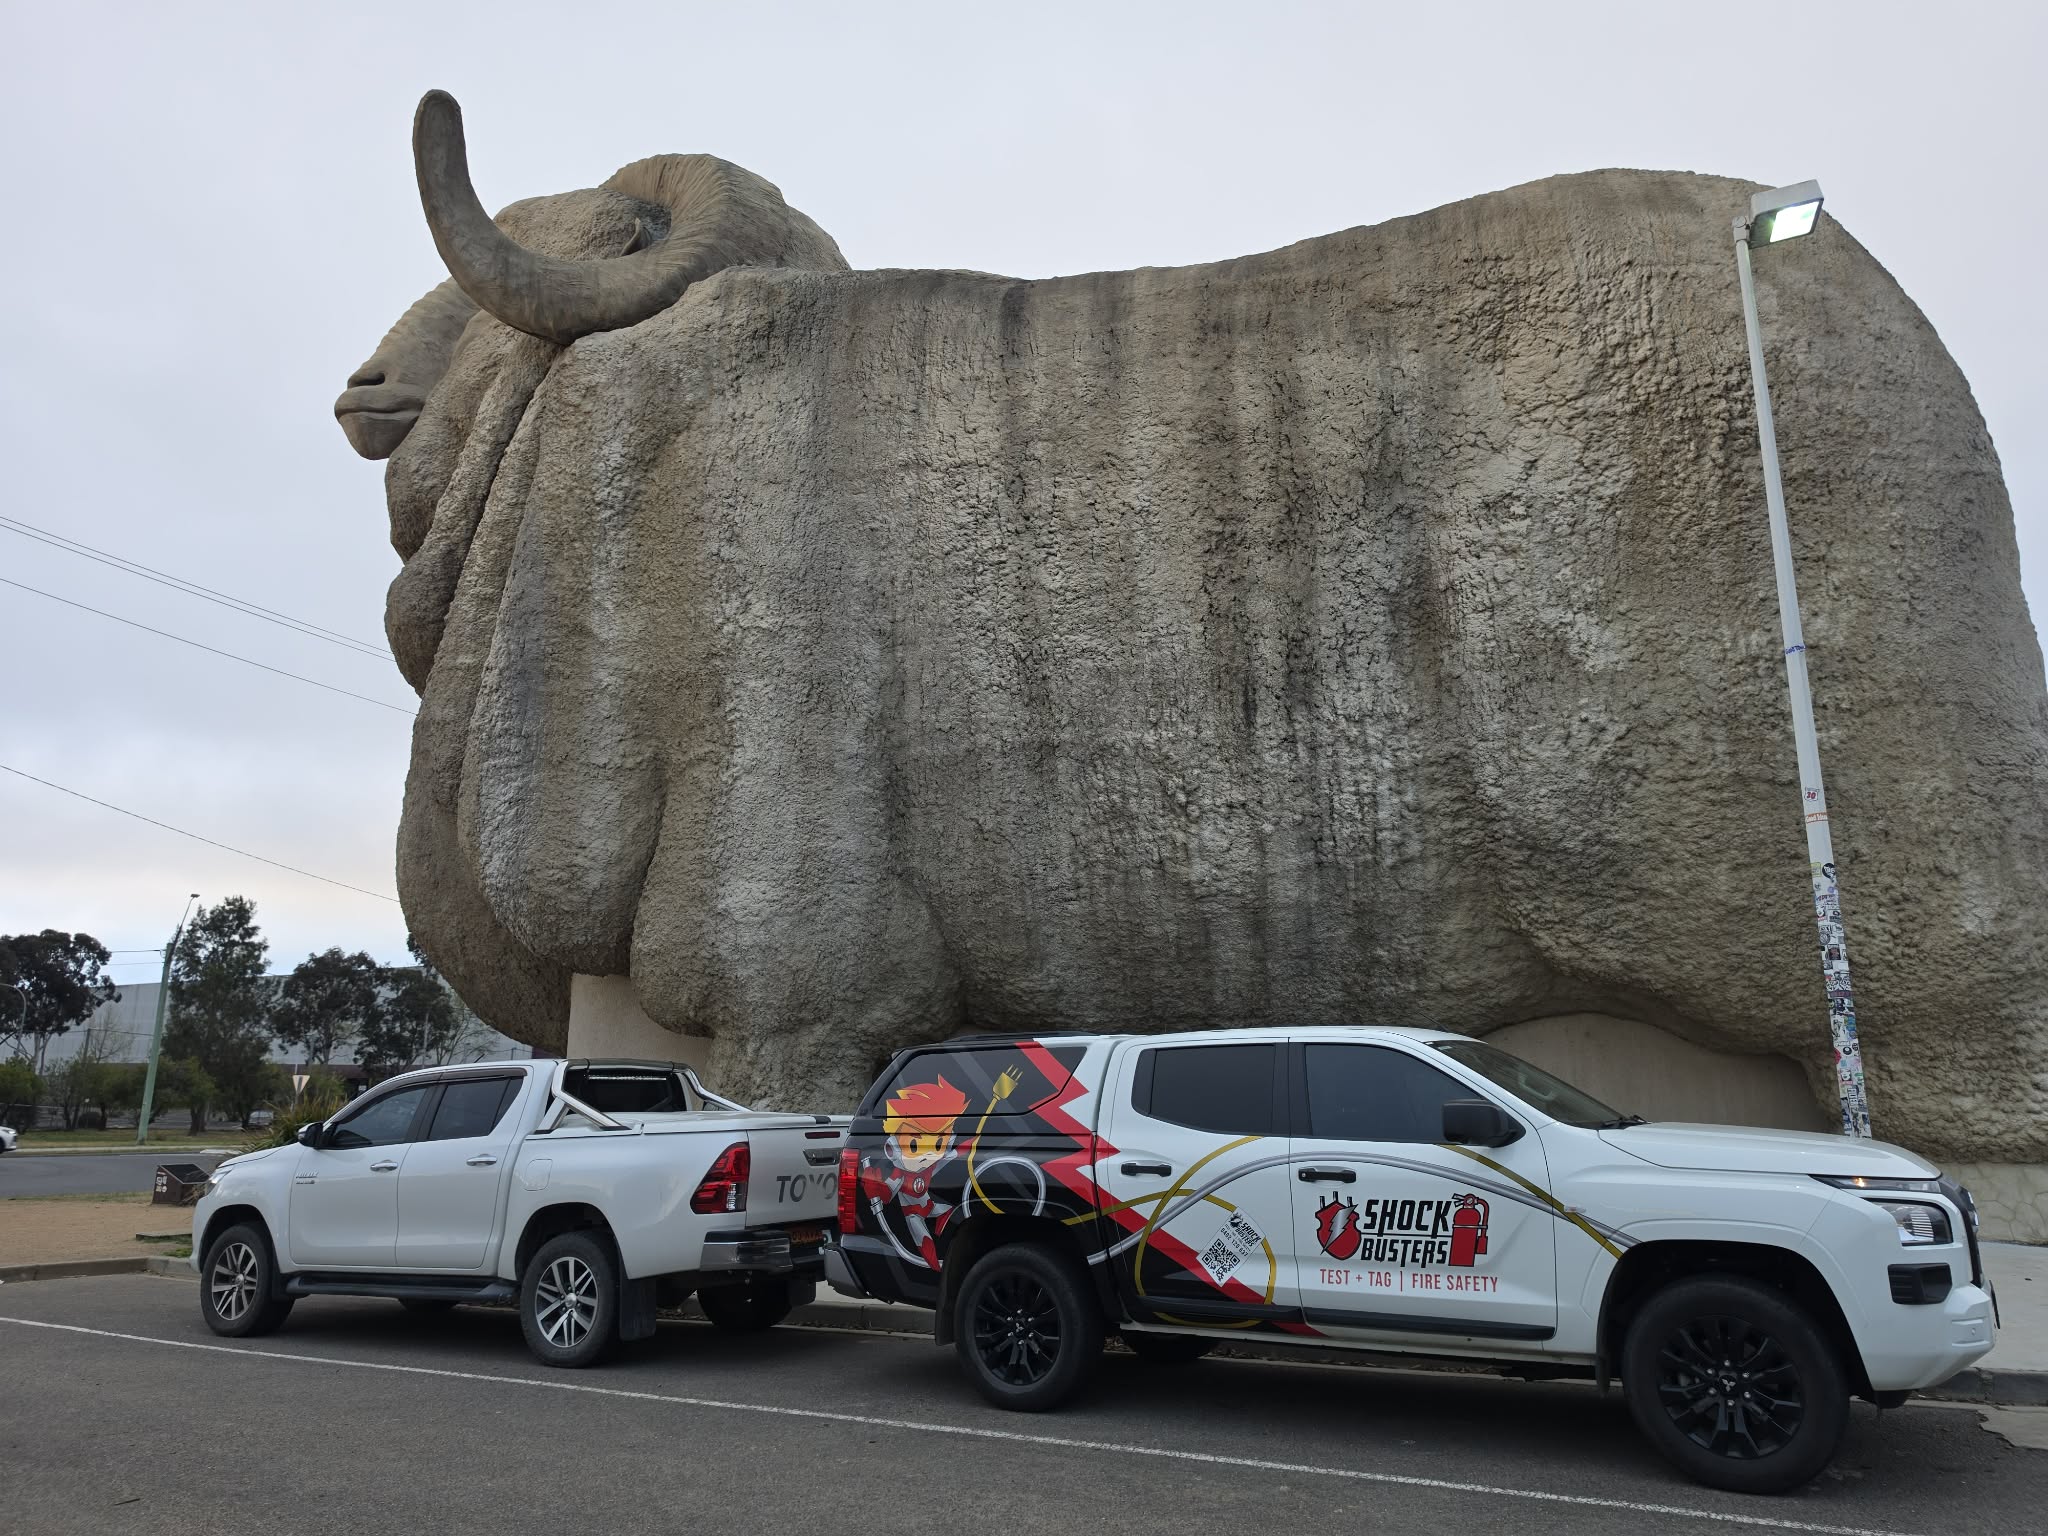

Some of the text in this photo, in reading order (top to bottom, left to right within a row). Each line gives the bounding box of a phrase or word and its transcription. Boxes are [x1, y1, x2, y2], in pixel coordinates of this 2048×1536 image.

[1240, 1222, 1261, 1243] SHOCK
[1363, 1199, 1452, 1239] SHOCK
[1360, 1238, 1449, 1268] BUSTERS
[1319, 1268, 1350, 1285] TEST
[1368, 1271, 1392, 1287] TAG
[1412, 1273, 1441, 1289] FIRE
[1446, 1275, 1498, 1292] SAFETY
